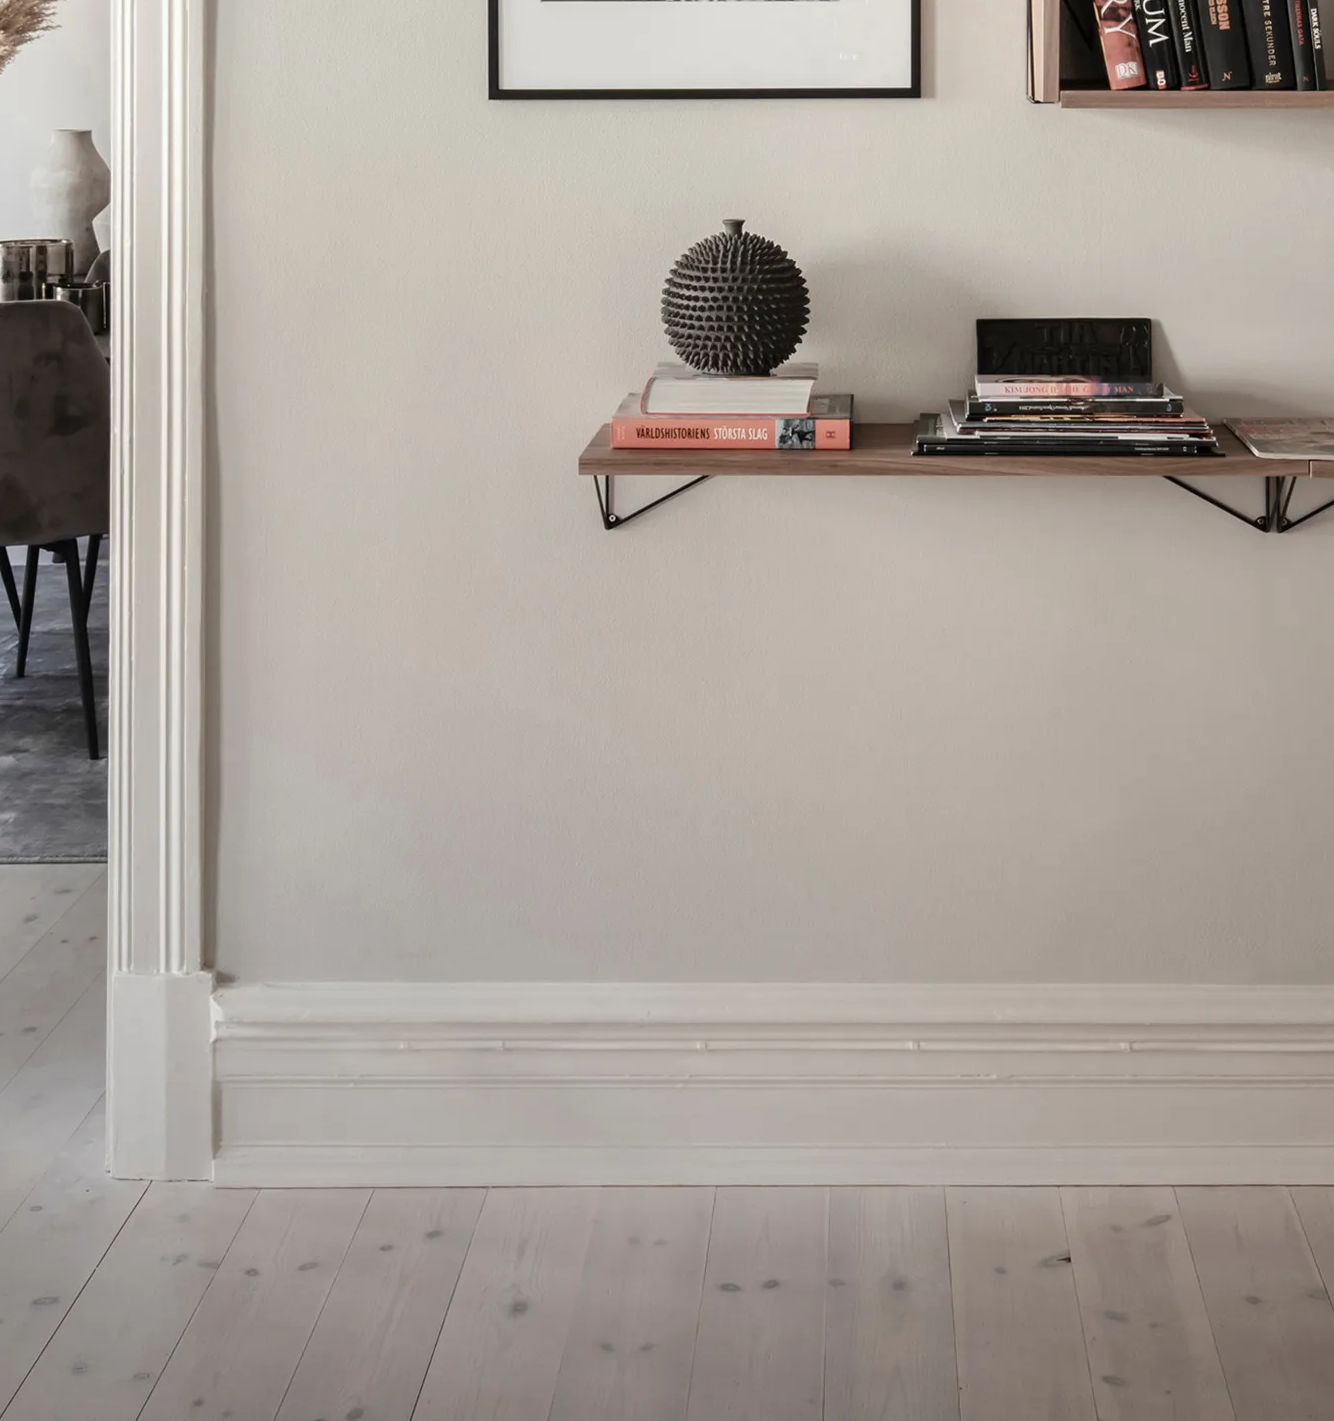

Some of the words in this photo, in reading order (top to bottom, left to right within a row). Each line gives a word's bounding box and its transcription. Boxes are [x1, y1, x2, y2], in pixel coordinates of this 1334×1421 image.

[1311, 8, 1319, 28] DARK
[1182, 29, 1193, 53] Man
[1264, 18, 1277, 66] SEKUNDER
[1004, 386, 1023, 394] KIM
[1024, 386, 1047, 394] JONG
[1114, 386, 1134, 394] MAN
[636, 425, 710, 440] VÄRLDSHISTORIENS
[713, 425, 747, 440] STÖRSTA
[749, 426, 768, 440] SLAG
